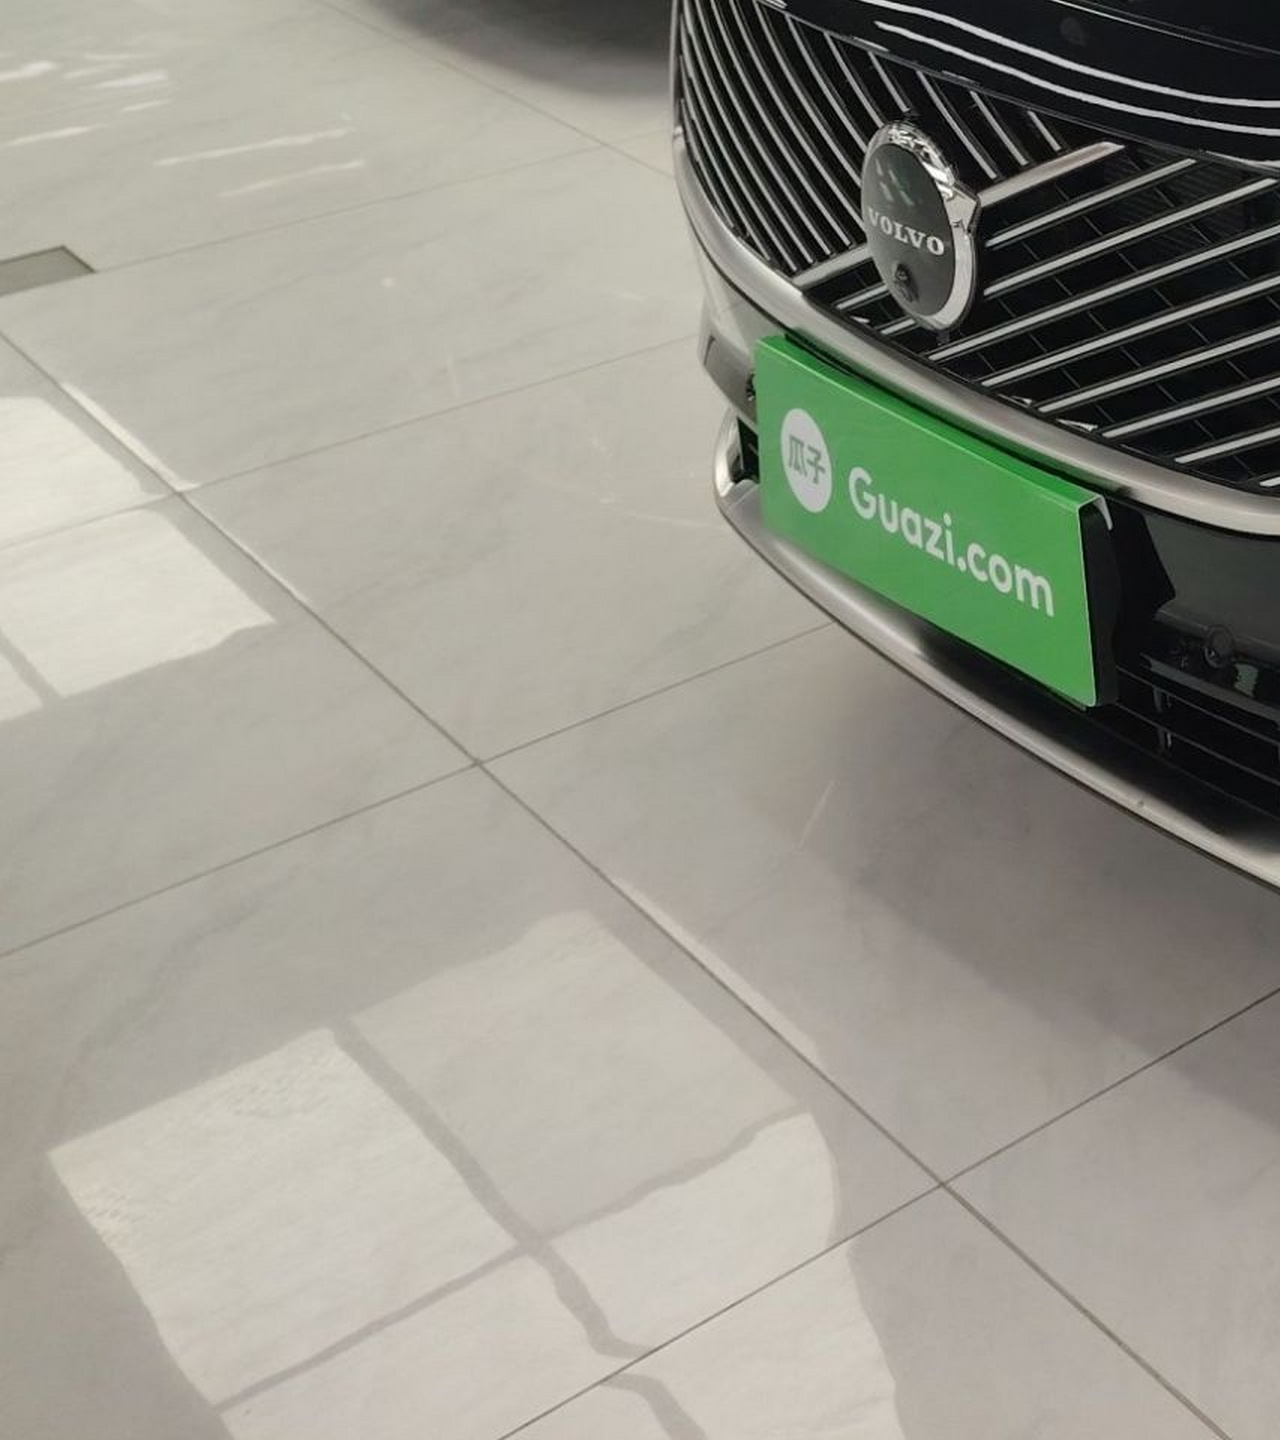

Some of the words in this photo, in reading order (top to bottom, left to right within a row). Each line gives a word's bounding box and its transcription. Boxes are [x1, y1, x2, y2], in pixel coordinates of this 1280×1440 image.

[867, 206, 945, 256] VOLVO
[787, 434, 827, 486] 瓜子
[848, 466, 1054, 617] Guazi.com
